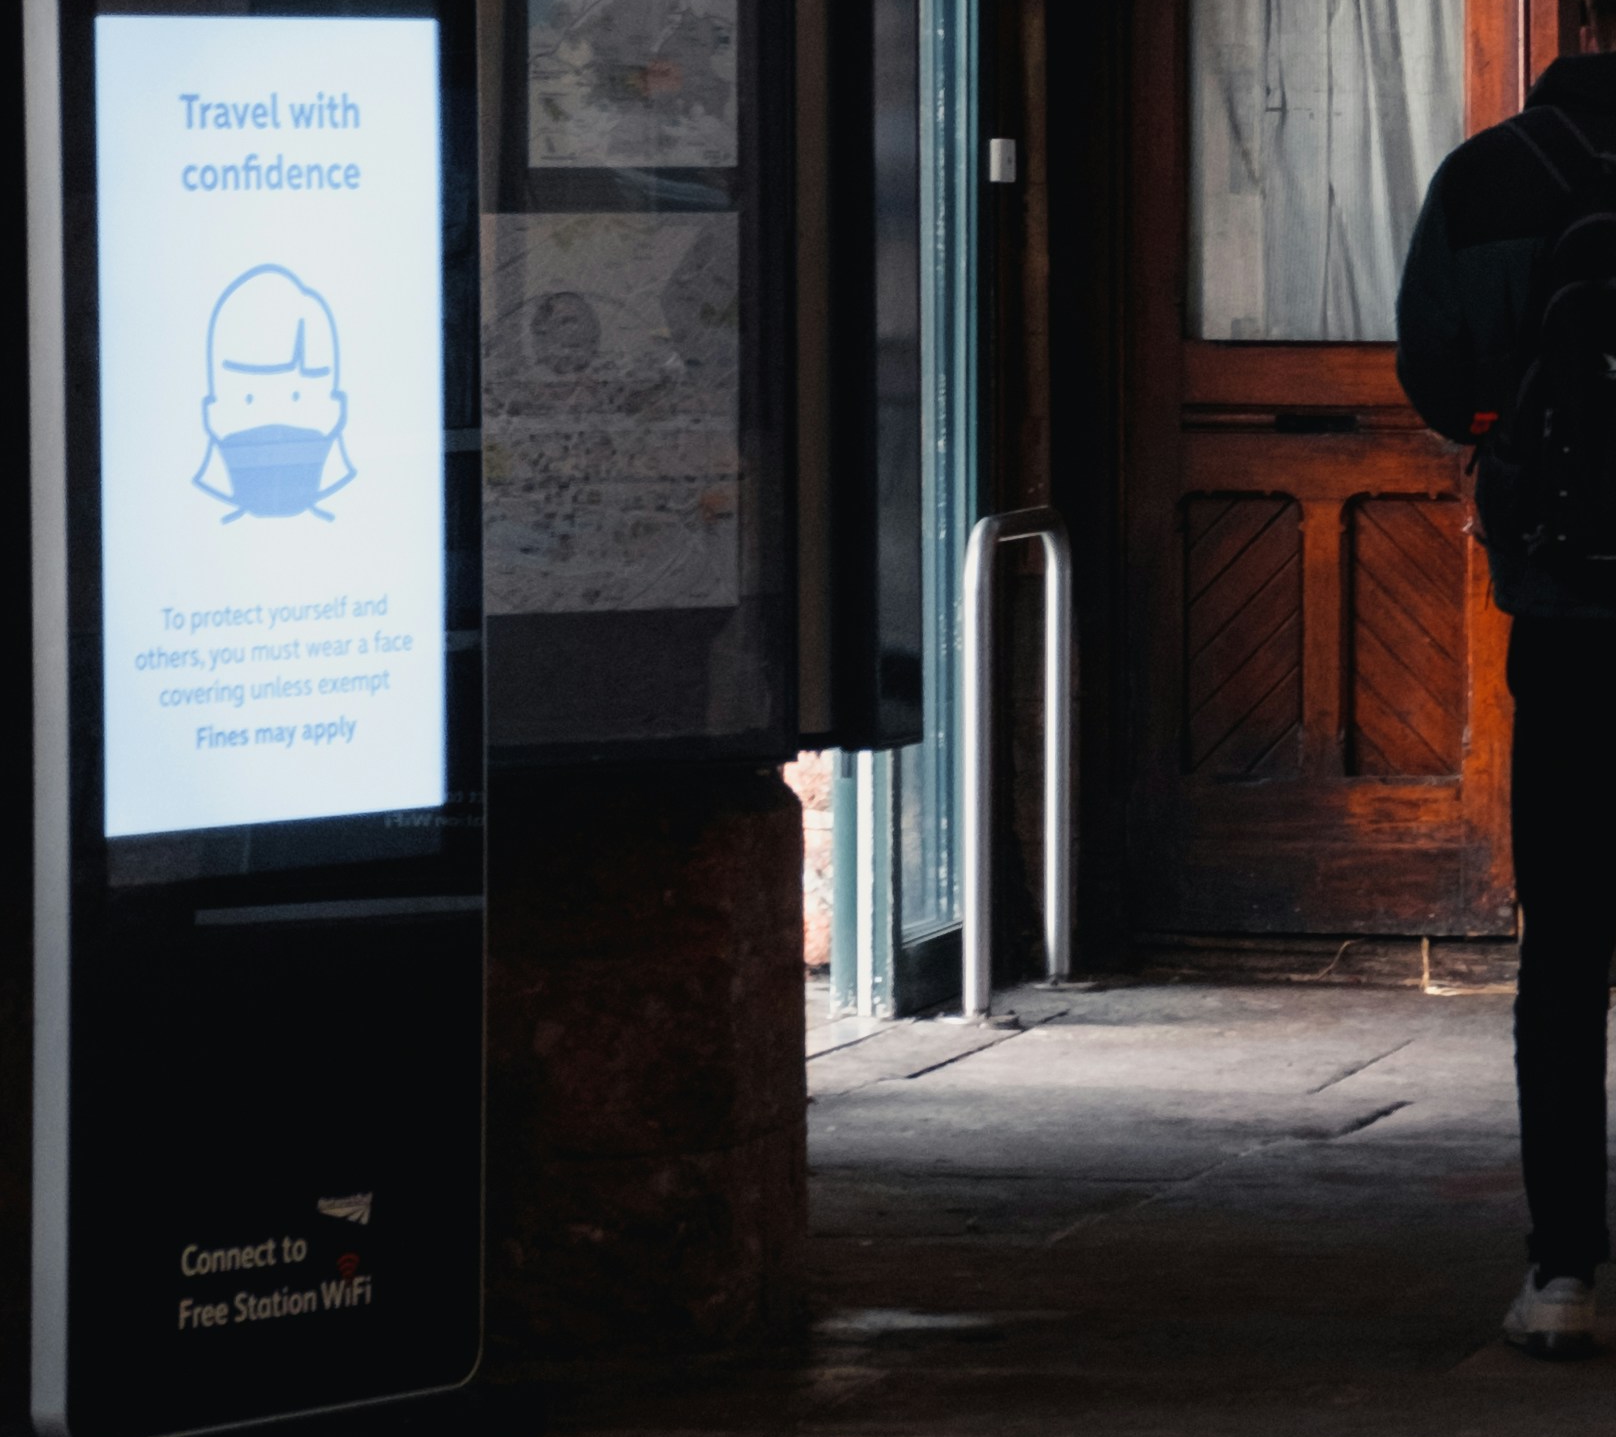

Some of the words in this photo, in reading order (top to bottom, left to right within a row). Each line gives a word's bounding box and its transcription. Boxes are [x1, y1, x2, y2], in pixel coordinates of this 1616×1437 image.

[179, 93, 281, 129] Travel
[290, 93, 361, 129] with
[182, 154, 361, 191] confidence
[162, 606, 184, 630] To
[191, 604, 263, 634] protect
[268, 595, 347, 628] yourself
[353, 594, 388, 617] and
[135, 645, 205, 671] others,
[209, 645, 245, 670] you
[252, 639, 300, 662] must
[306, 635, 351, 657] wear
[358, 636, 368, 653] a
[374, 630, 413, 653] face
[159, 681, 245, 708] covering
[251, 676, 312, 700] unless
[318, 670, 390, 697] exempt
[196, 724, 249, 749] Fines
[255, 725, 296, 748] may
[302, 715, 357, 744] apply
[180, 1238, 276, 1277] Connect
[282, 1235, 308, 1264] to
[178, 1297, 229, 1330] Free
[233, 1285, 317, 1324] Station
[320, 1275, 372, 1310] WiFi
